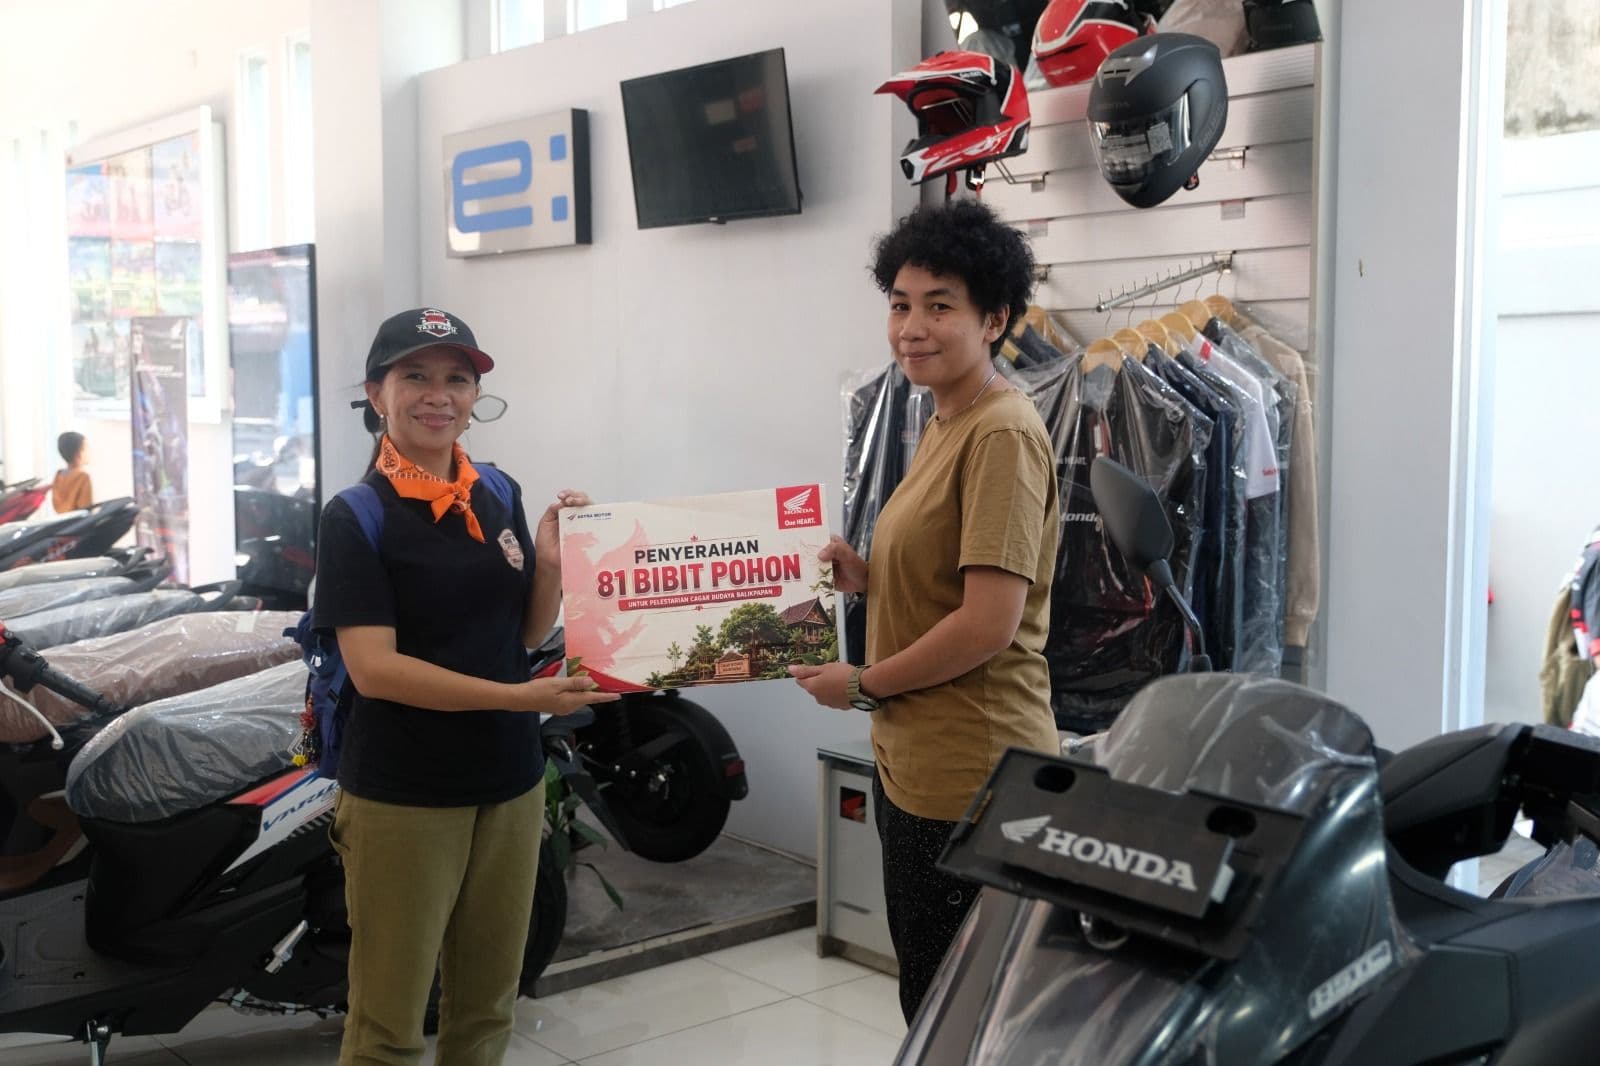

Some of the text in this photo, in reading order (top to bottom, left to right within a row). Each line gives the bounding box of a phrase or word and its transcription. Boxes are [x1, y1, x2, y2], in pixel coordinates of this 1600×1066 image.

[452, 134, 568, 234] e:
[634, 539, 759, 564] PENYERAHAN
[597, 553, 801, 598] 81 BIBIT POHON
[628, 588, 773, 608] UNTUK PELESTARIAN CAGAR BUDAYA BALIKPAPAN
[1038, 826, 1198, 892] HONDA
